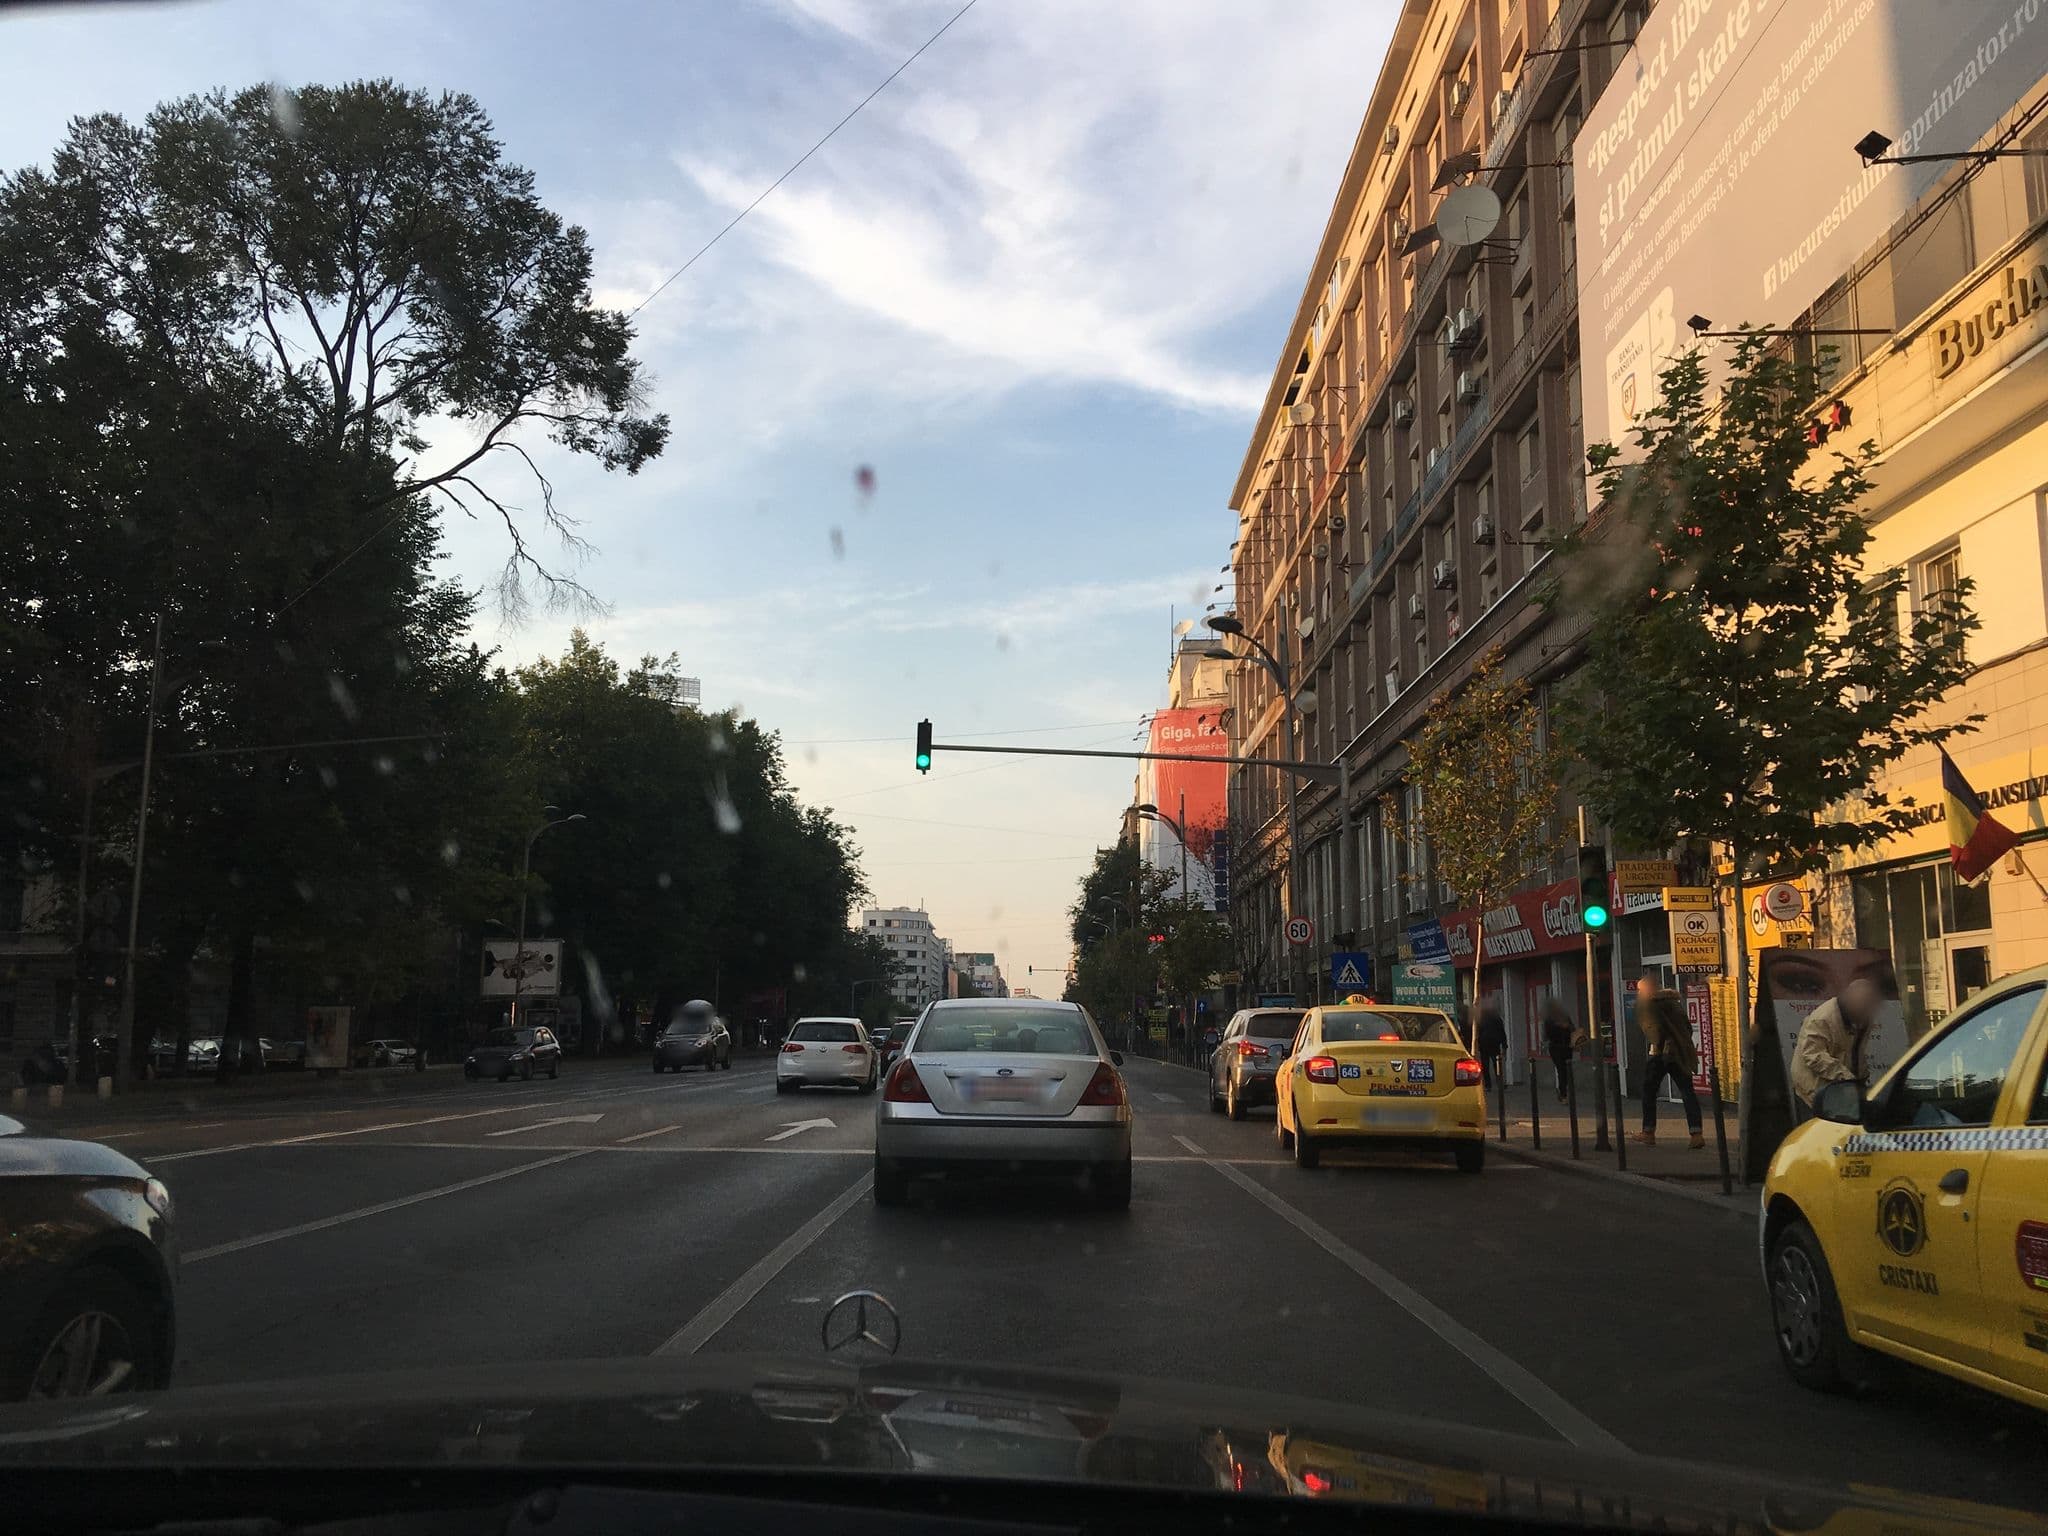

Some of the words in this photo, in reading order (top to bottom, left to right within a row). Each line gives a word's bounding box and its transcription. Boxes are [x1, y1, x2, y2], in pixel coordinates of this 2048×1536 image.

[1671, 0, 1713, 61] lib
[1617, 81, 1684, 222] primul
[1687, 0, 1751, 111] skate
[1643, 239, 1654, 261] cu
[1654, 193, 1687, 246] oameni
[1733, 108, 1756, 145] care
[1757, 74, 1781, 117] aleg
[1781, 0, 1833, 84] branduri
[1625, 257, 1664, 313] cunoscute
[1665, 237, 1680, 264] din
[1739, 151, 1751, 173] le
[1780, 87, 1801, 121] din
[1624, 384, 1634, 404] BT
[1161, 726, 1196, 741] Giga,
[1904, 803, 1946, 829] ANCA
[1291, 923, 1308, 938] 60
[1687, 921, 1705, 930] OK
[1676, 937, 1718, 945] EXCHANGE
[1678, 965, 1697, 973] NON
[1698, 965, 1719, 973] STOP
[1341, 1067, 1359, 1078] 645
[1370, 1082, 1425, 1090] PELICANUL
[1878, 1263, 1940, 1296] CRISTAXI
